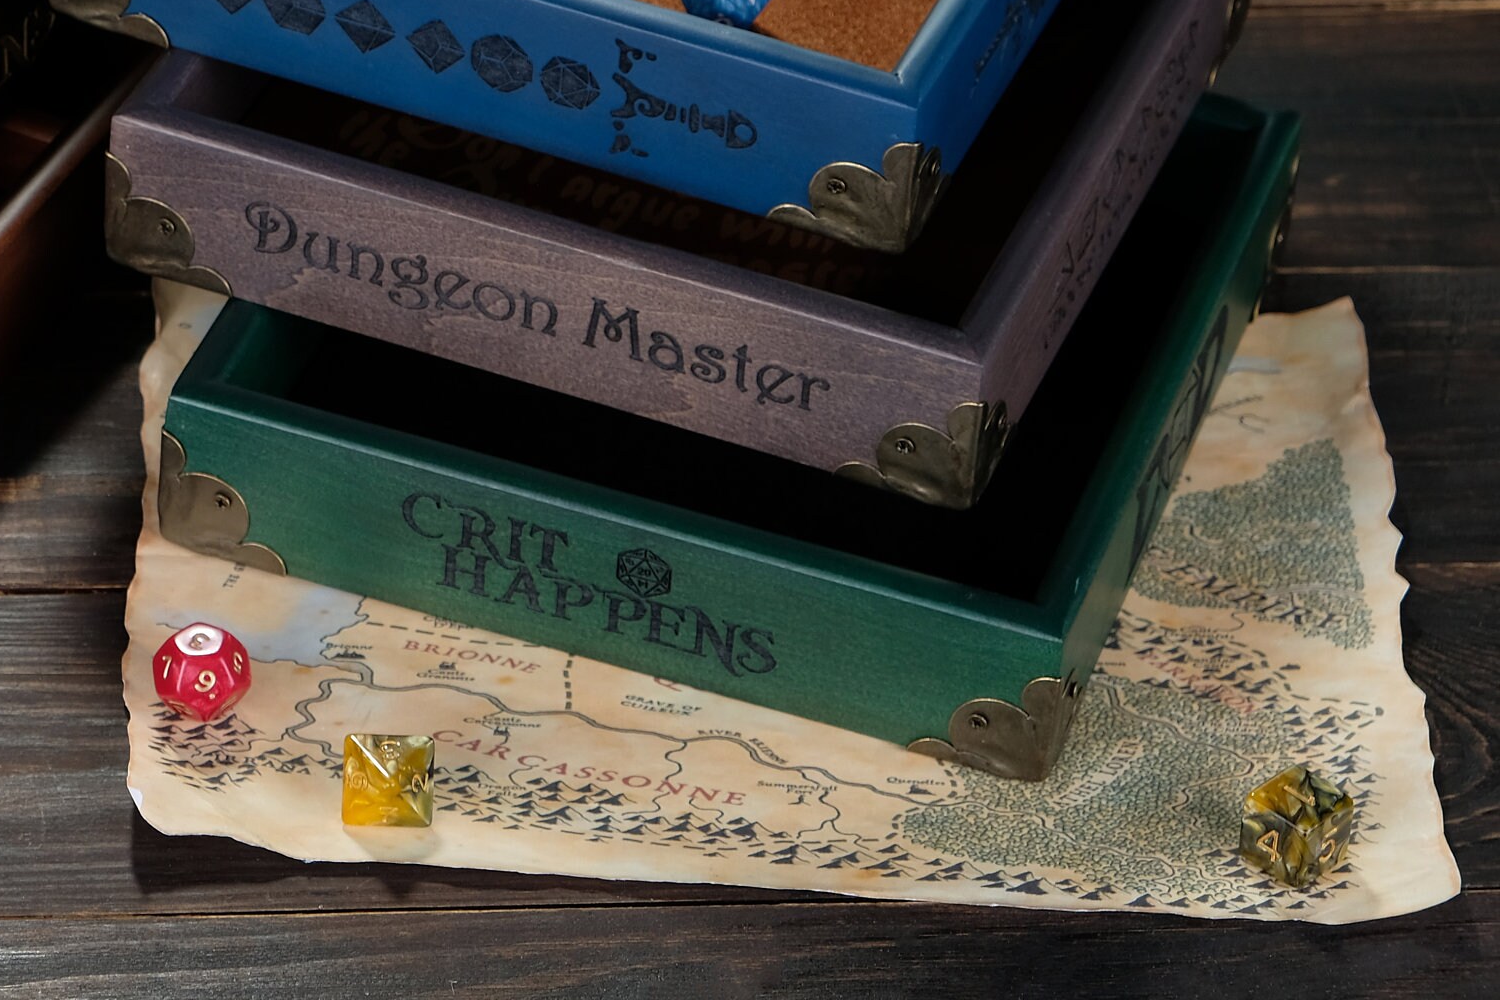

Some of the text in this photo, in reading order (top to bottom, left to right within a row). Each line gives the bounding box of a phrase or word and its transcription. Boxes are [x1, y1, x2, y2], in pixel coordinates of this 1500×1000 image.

[245, 201, 831, 411] Dungeon Master
[401, 491, 570, 578] CRIT
[436, 544, 777, 676] HAPPENS
[325, 642, 373, 651] Brionne
[404, 640, 541, 675] BRIONNE
[162, 655, 172, 680] 7
[625, 694, 702, 713] GRAVE OF
[697, 729, 742, 739] RIVER
[432, 730, 747, 806] CARCASSONNE
[1256, 829, 1280, 863] 4
